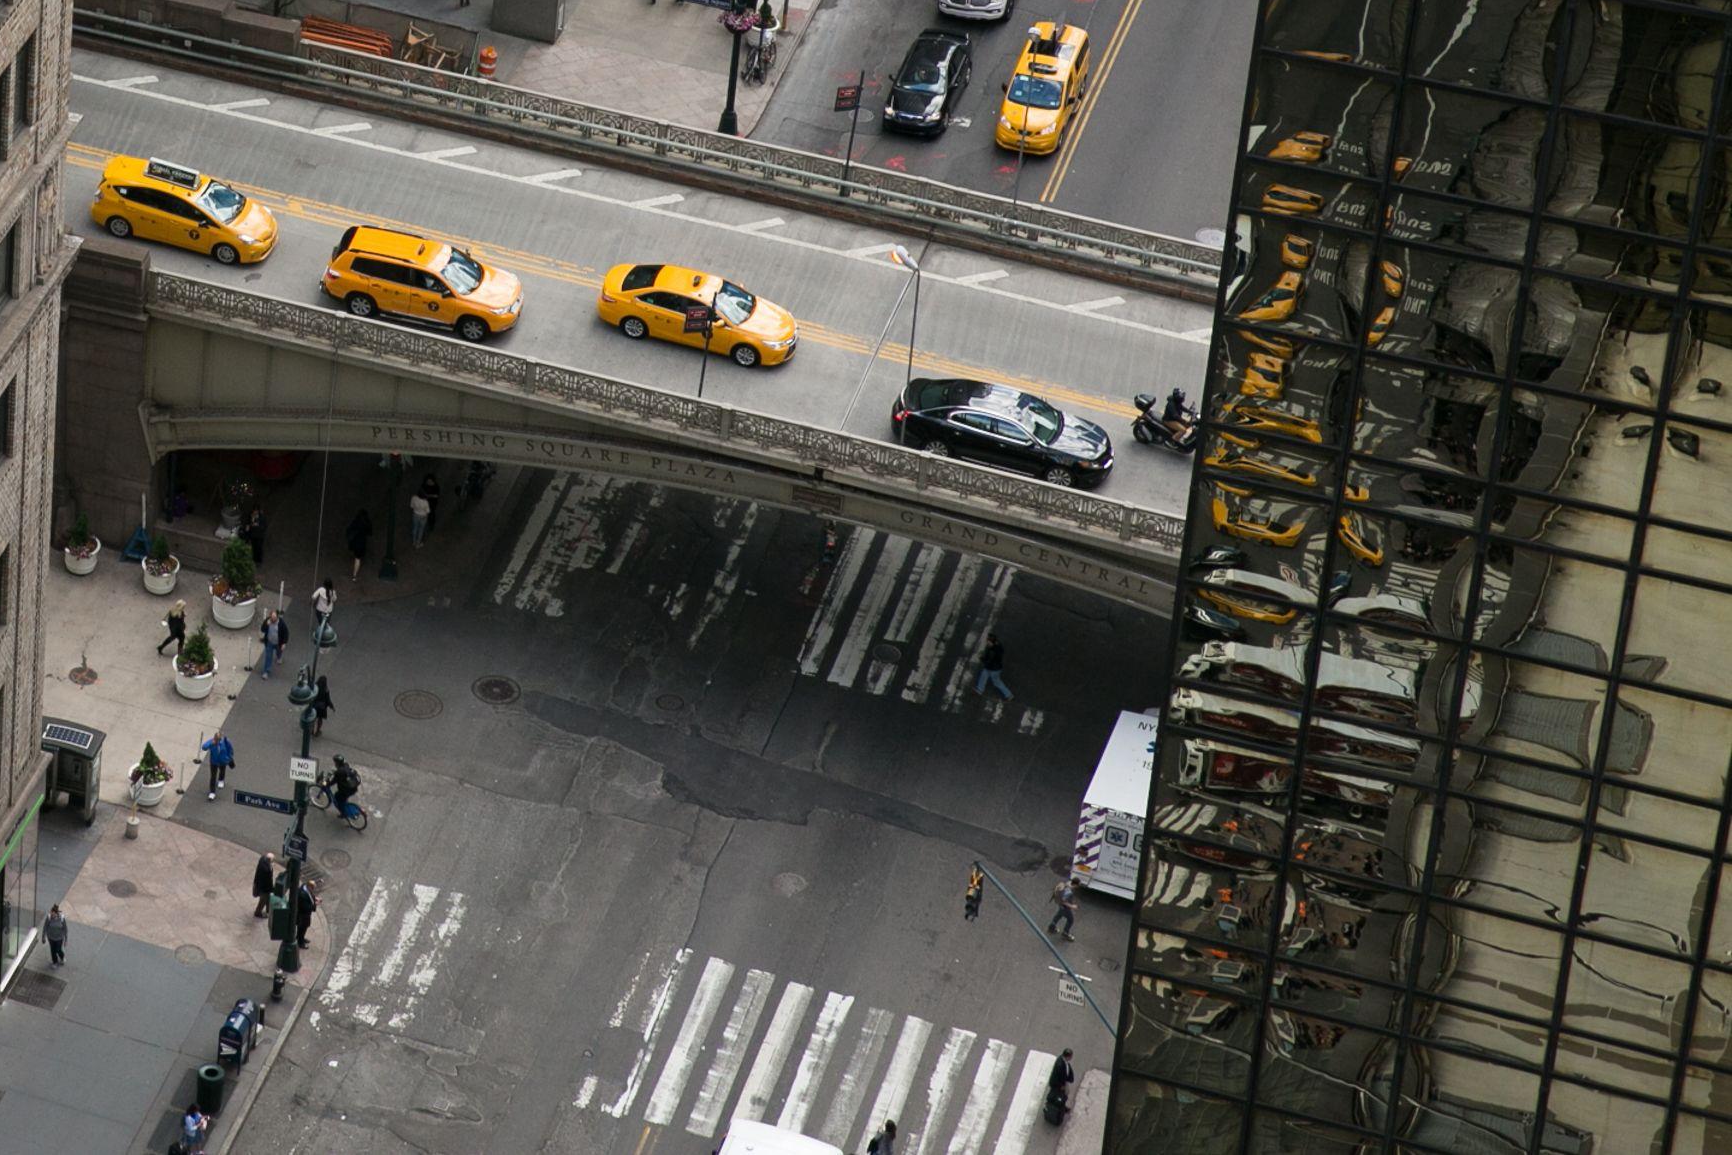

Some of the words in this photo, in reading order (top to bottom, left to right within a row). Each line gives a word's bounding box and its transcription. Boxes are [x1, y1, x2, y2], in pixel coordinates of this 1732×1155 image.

[372, 426, 506, 448] PERSHING
[526, 439, 631, 464] SQUARE
[651, 456, 736, 483] PLAZA
[900, 511, 998, 546] GRAND
[1019, 543, 1149, 595] CENTRAL
[297, 761, 309, 770] NO
[291, 769, 314, 779] TURNS
[245, 795, 263, 805] Park
[265, 799, 280, 809] Ave
[1066, 983, 1077, 992] NO
[1059, 990, 1083, 1003] TURNS
